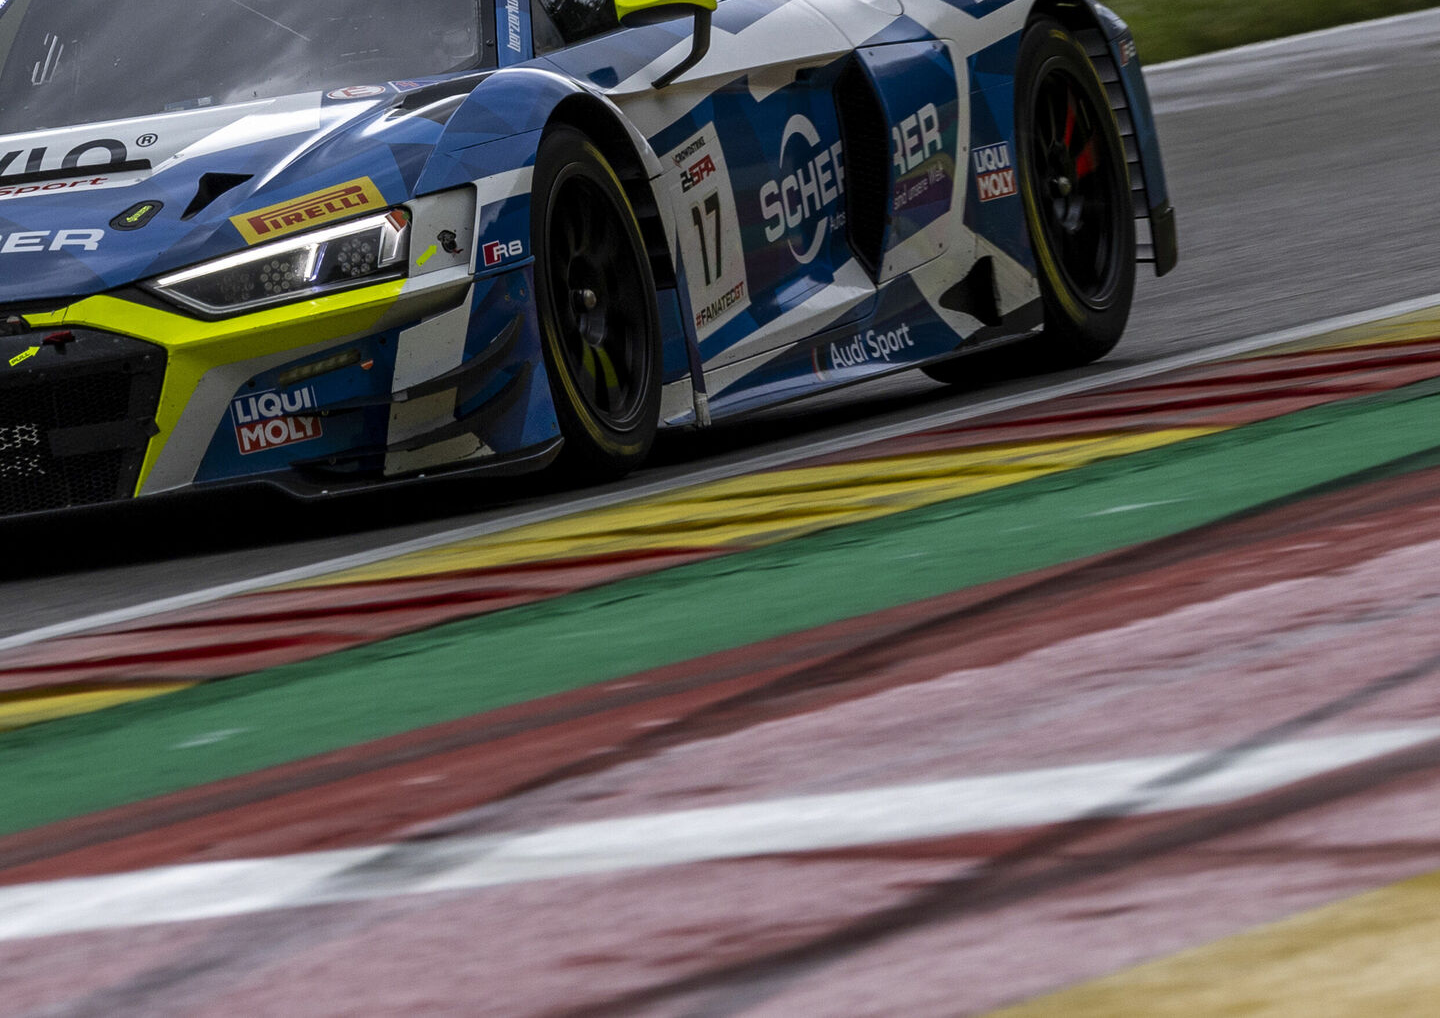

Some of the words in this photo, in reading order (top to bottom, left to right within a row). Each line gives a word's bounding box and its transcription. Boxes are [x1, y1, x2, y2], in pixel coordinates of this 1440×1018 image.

[973, 145, 1011, 173] LIQUI
[977, 169, 1014, 199] MOLY
[247, 185, 369, 235] PIRELLI
[492, 239, 523, 262] R8
[691, 191, 722, 287] 17
[830, 333, 869, 370] Audi
[866, 322, 915, 361] Sport
[235, 386, 312, 424] LIQUI
[240, 415, 314, 451] MOLY
